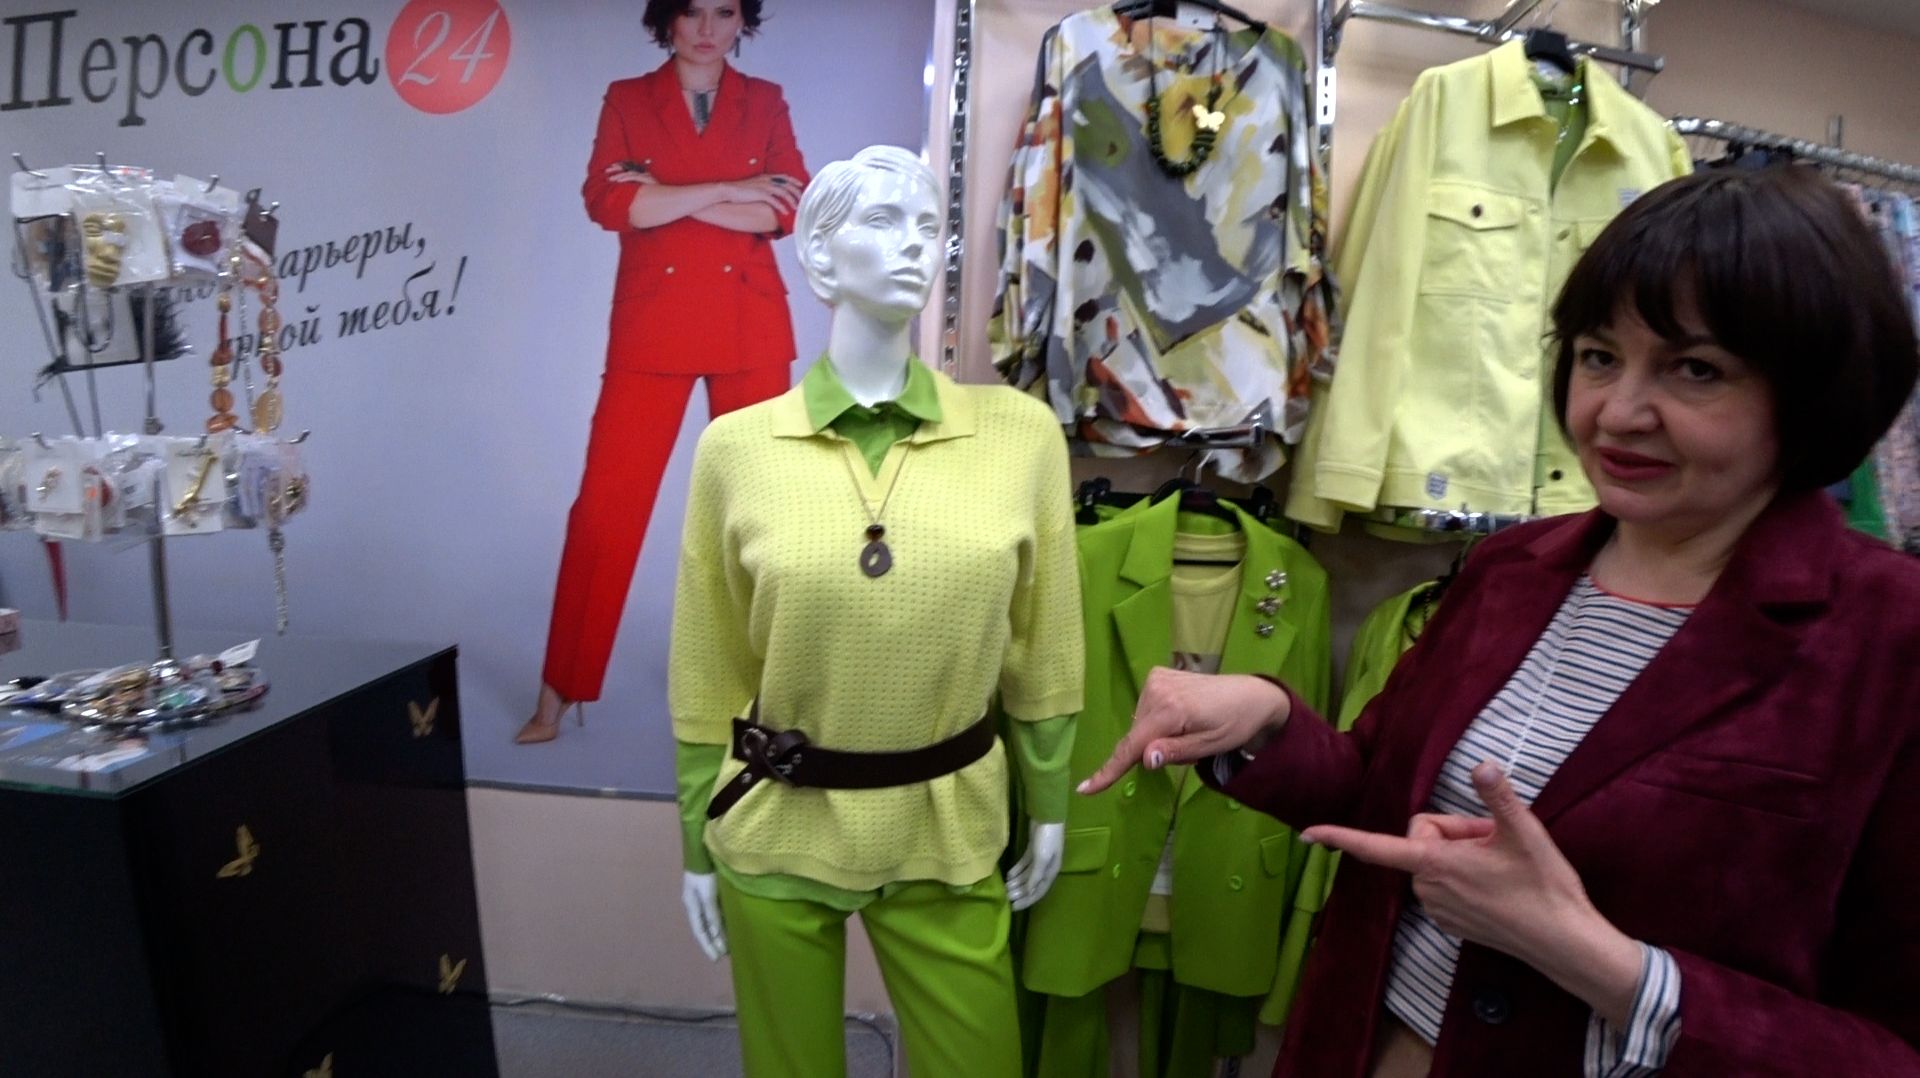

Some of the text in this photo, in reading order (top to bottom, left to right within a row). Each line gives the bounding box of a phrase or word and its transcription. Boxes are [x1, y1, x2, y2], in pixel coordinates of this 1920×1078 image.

[1, 7, 500, 127] Персона 24
[270, 221, 426, 293] арьеры,
[337, 256, 468, 337] тебя!
